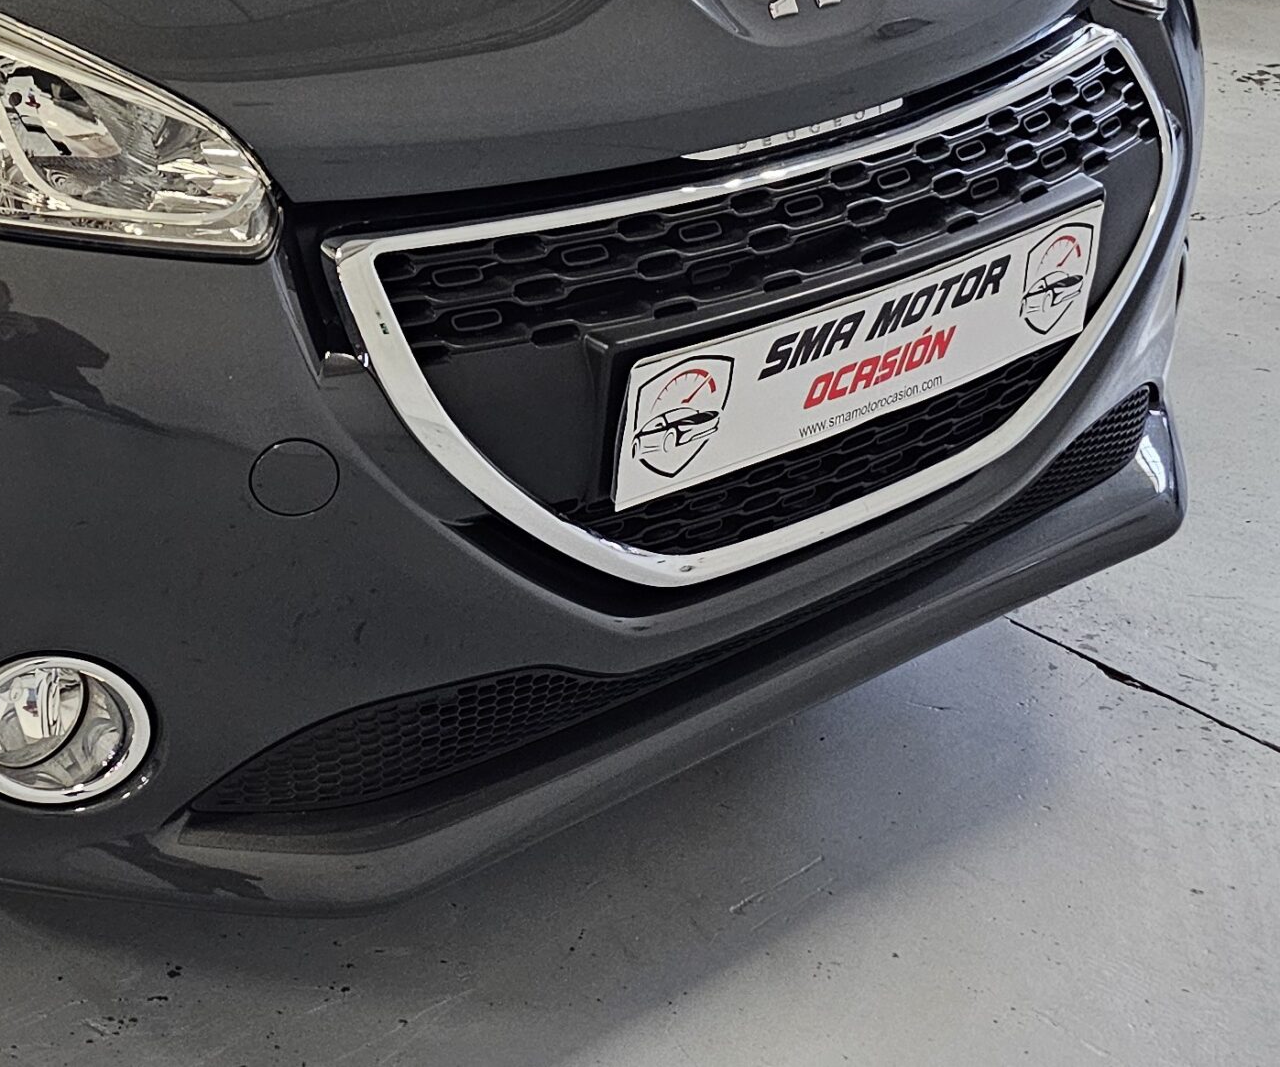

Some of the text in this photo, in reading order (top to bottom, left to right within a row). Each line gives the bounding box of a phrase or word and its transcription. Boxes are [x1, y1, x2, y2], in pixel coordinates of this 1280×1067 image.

[758, 254, 1012, 381] SMA MOTOR
[798, 374, 943, 438] www.smamotorocasion.com
[803, 325, 957, 410] OCASIÓN
